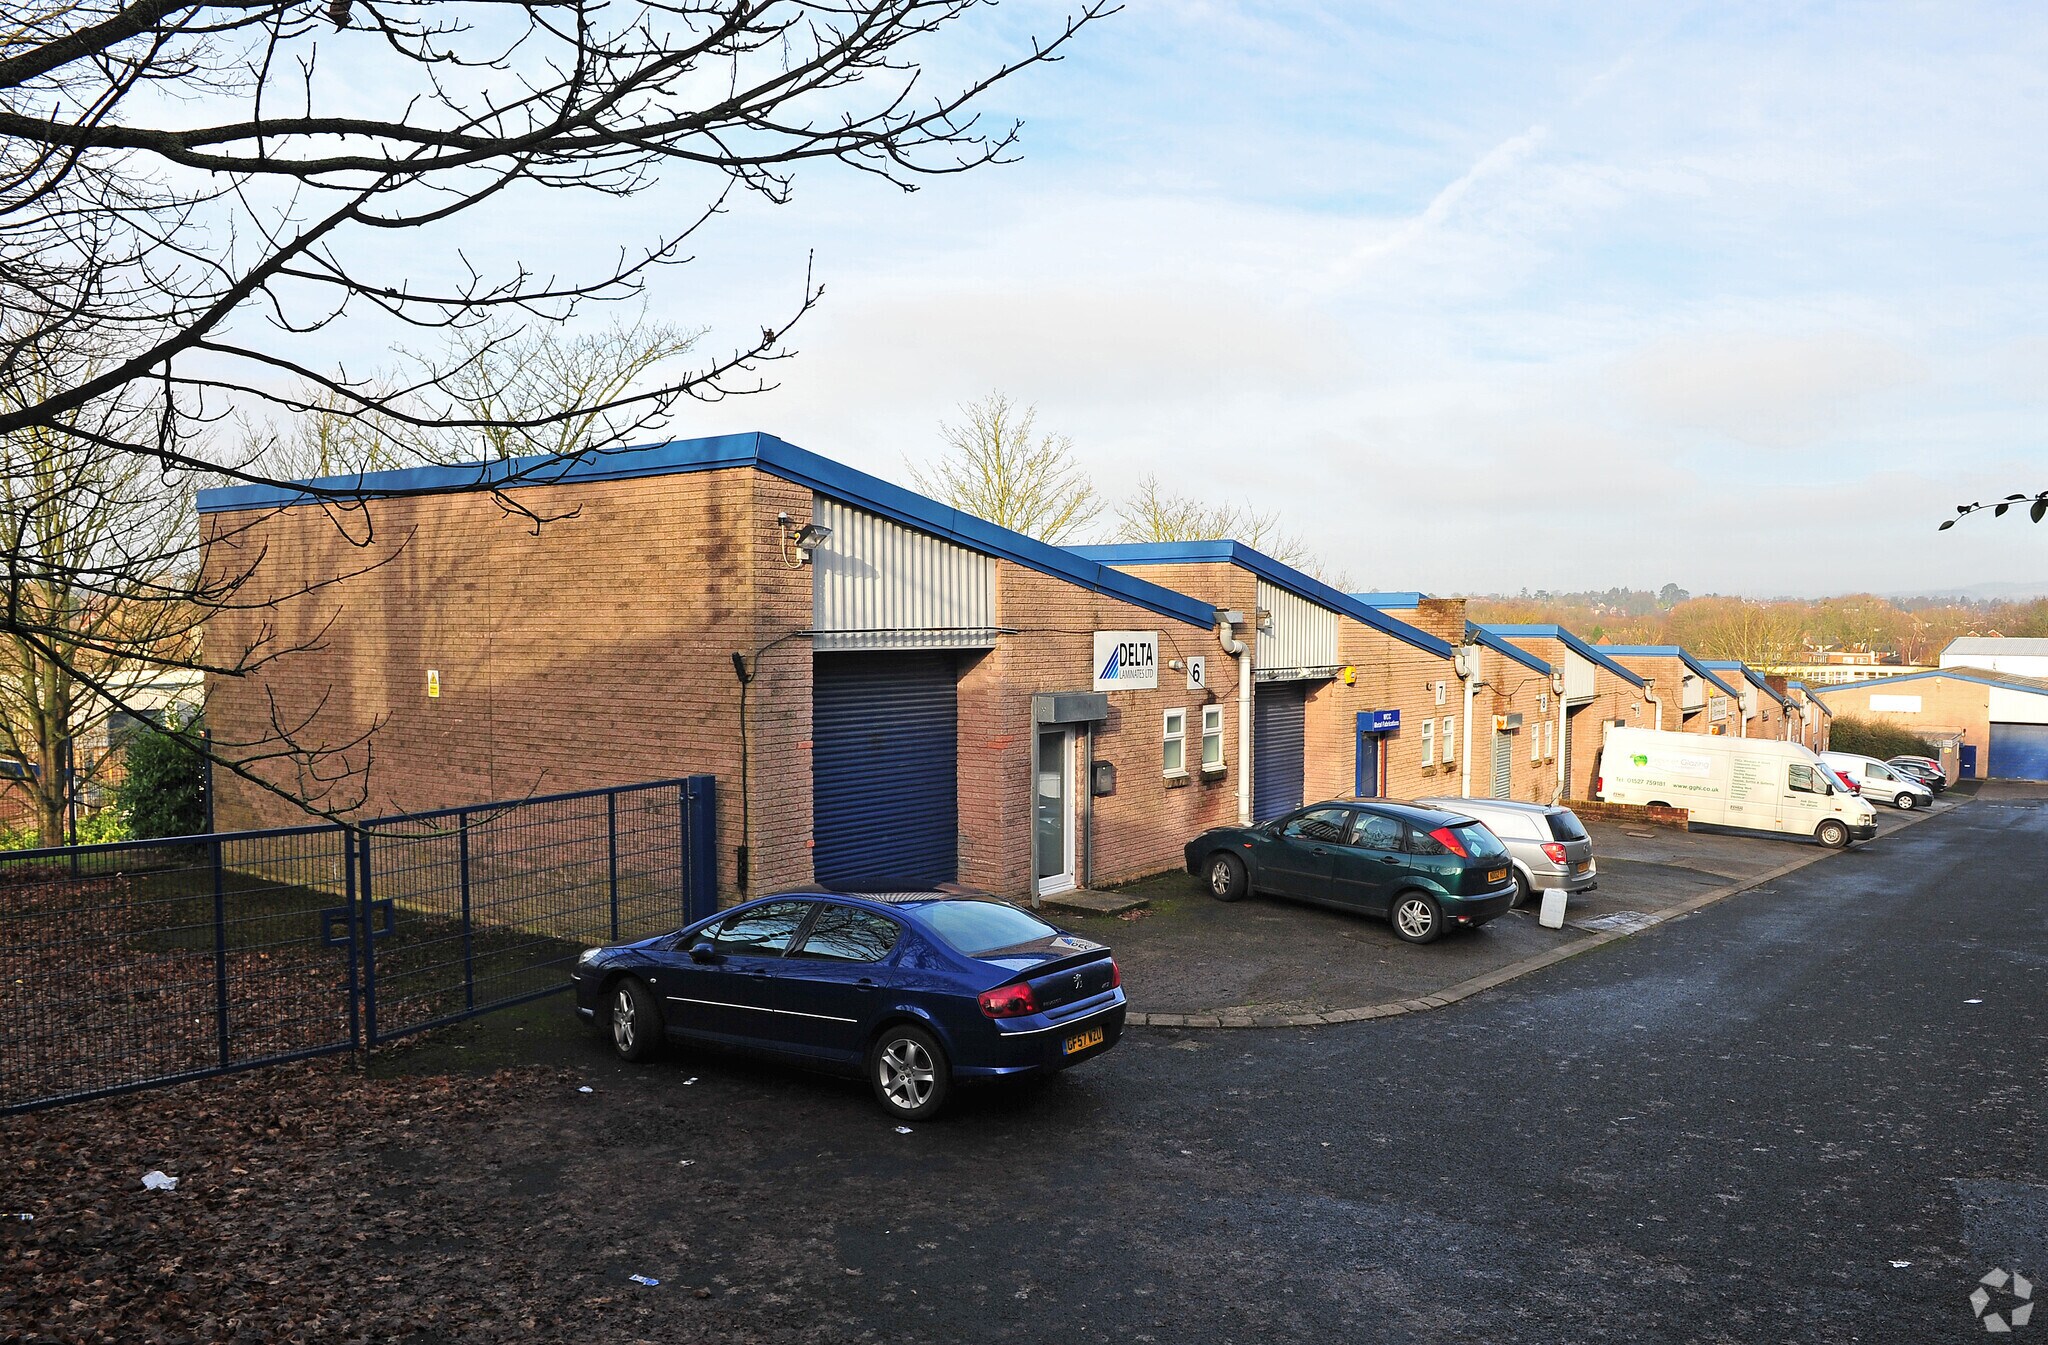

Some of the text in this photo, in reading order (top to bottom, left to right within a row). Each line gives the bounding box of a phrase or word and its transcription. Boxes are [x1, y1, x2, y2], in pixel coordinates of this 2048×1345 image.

[1119, 643, 1153, 667] DELTA
[1120, 668, 1154, 680] LAMINATES LTD
[1192, 663, 1200, 682] 6
[1439, 686, 1443, 699] 7
